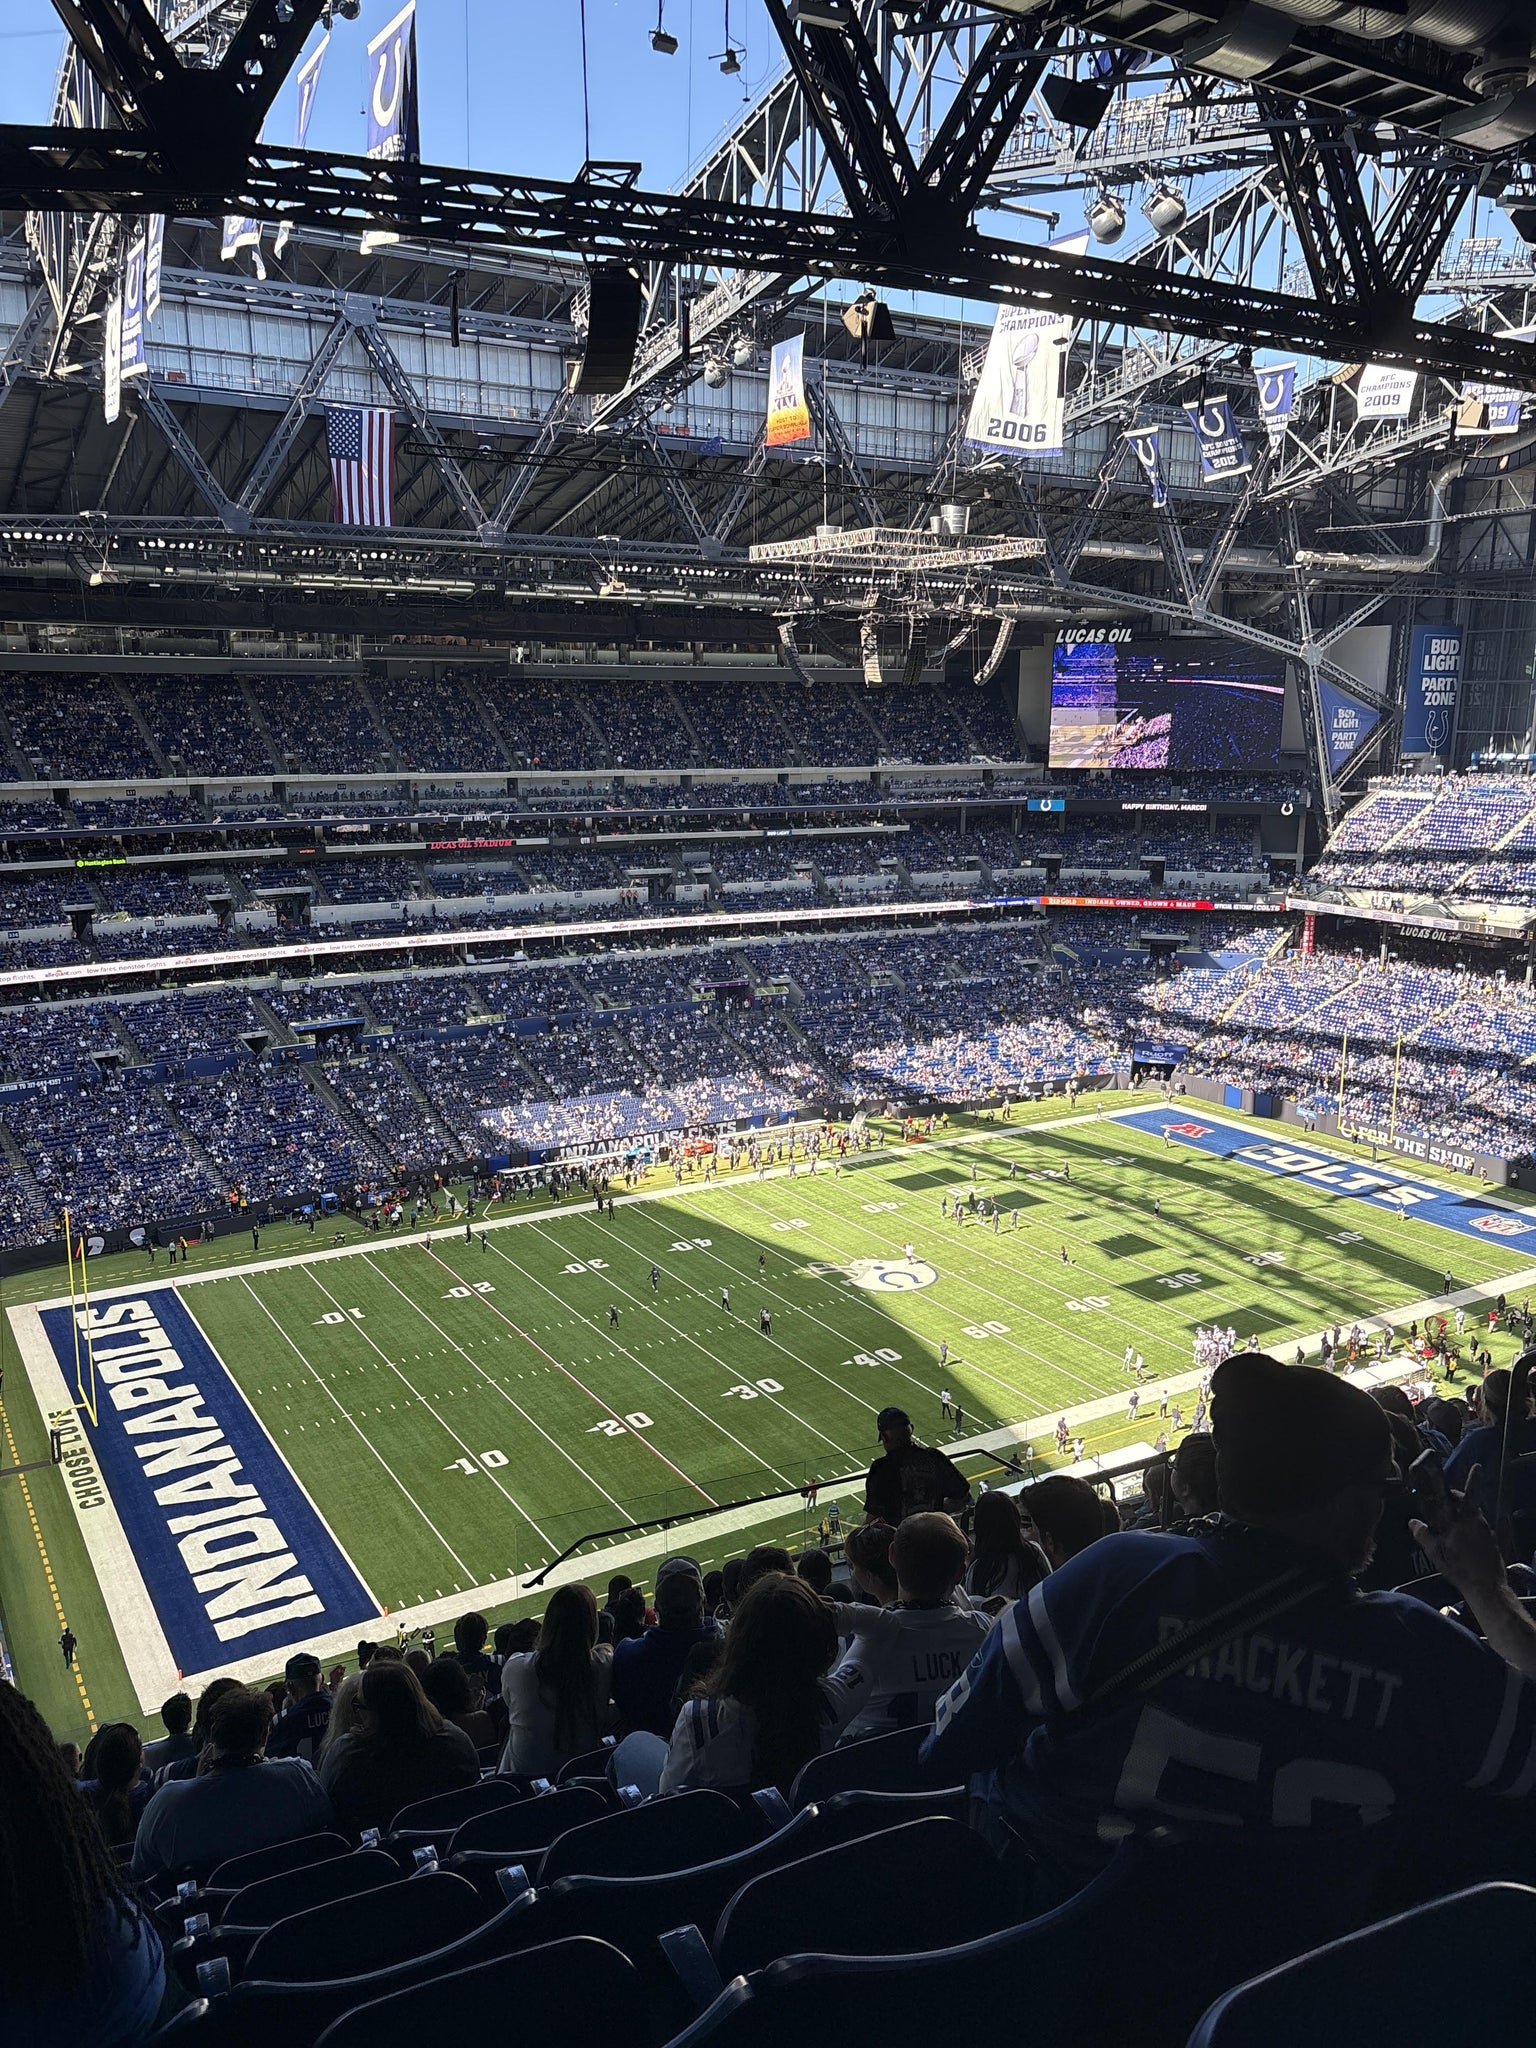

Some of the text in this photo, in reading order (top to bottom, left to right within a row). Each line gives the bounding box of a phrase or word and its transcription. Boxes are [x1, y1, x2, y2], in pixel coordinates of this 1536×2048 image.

[1000, 314, 1064, 333] CHAMPIONS
[1380, 374, 1396, 382] AFC
[1360, 380, 1412, 393] CHAMPIONS
[1364, 394, 1400, 407] 2009
[987, 417, 1047, 442] 2006
[1202, 444, 1242, 458] CHAMPIONS
[1056, 628, 1132, 642] LUCAS OIL
[1430, 638, 1460, 654] BUD
[1424, 692, 1456, 706] ZONE
[1338, 708, 1356, 718] BUD
[1334, 718, 1358, 728] LIGHT
[1332, 732, 1358, 741] PARTY
[1334, 740, 1354, 750] ZONE
[431, 842, 457, 850] LUCAS
[1256, 904, 1280, 912] COLTS
[1400, 926, 1431, 939] LUCAS
[1432, 930, 1447, 942] OIL
[1484, 926, 1494, 934] 13
[1358, 1126, 1389, 1147] FOR
[1392, 1136, 1427, 1158] THE
[1232, 1144, 1439, 1206] COLTS
[946, 1184, 982, 1197] 30
[1440, 1184, 1466, 1192] US
[860, 1200, 900, 1214] 40
[770, 1218, 811, 1232] 50
[678, 1238, 712, 1252] 40
[1325, 1232, 1358, 1244] 10
[568, 1258, 610, 1274] 30
[1243, 1251, 1281, 1268] 20
[1156, 1272, 1198, 1289] 30
[452, 1281, 496, 1298] 20
[1064, 1295, 1107, 1312] 40
[325, 1307, 366, 1326] 10
[960, 1320, 1012, 1340] 50
[853, 1347, 902, 1368] 40
[730, 1377, 785, 1400] 30
[596, 1412, 654, 1438] 20
[75, 1299, 326, 1642] INDIANAPOLIS
[456, 1449, 510, 1476] 10
[62, 1446, 106, 1511] CHOOSE
[914, 1651, 961, 1684] LUCK
[306, 1711, 330, 1729] LUC
